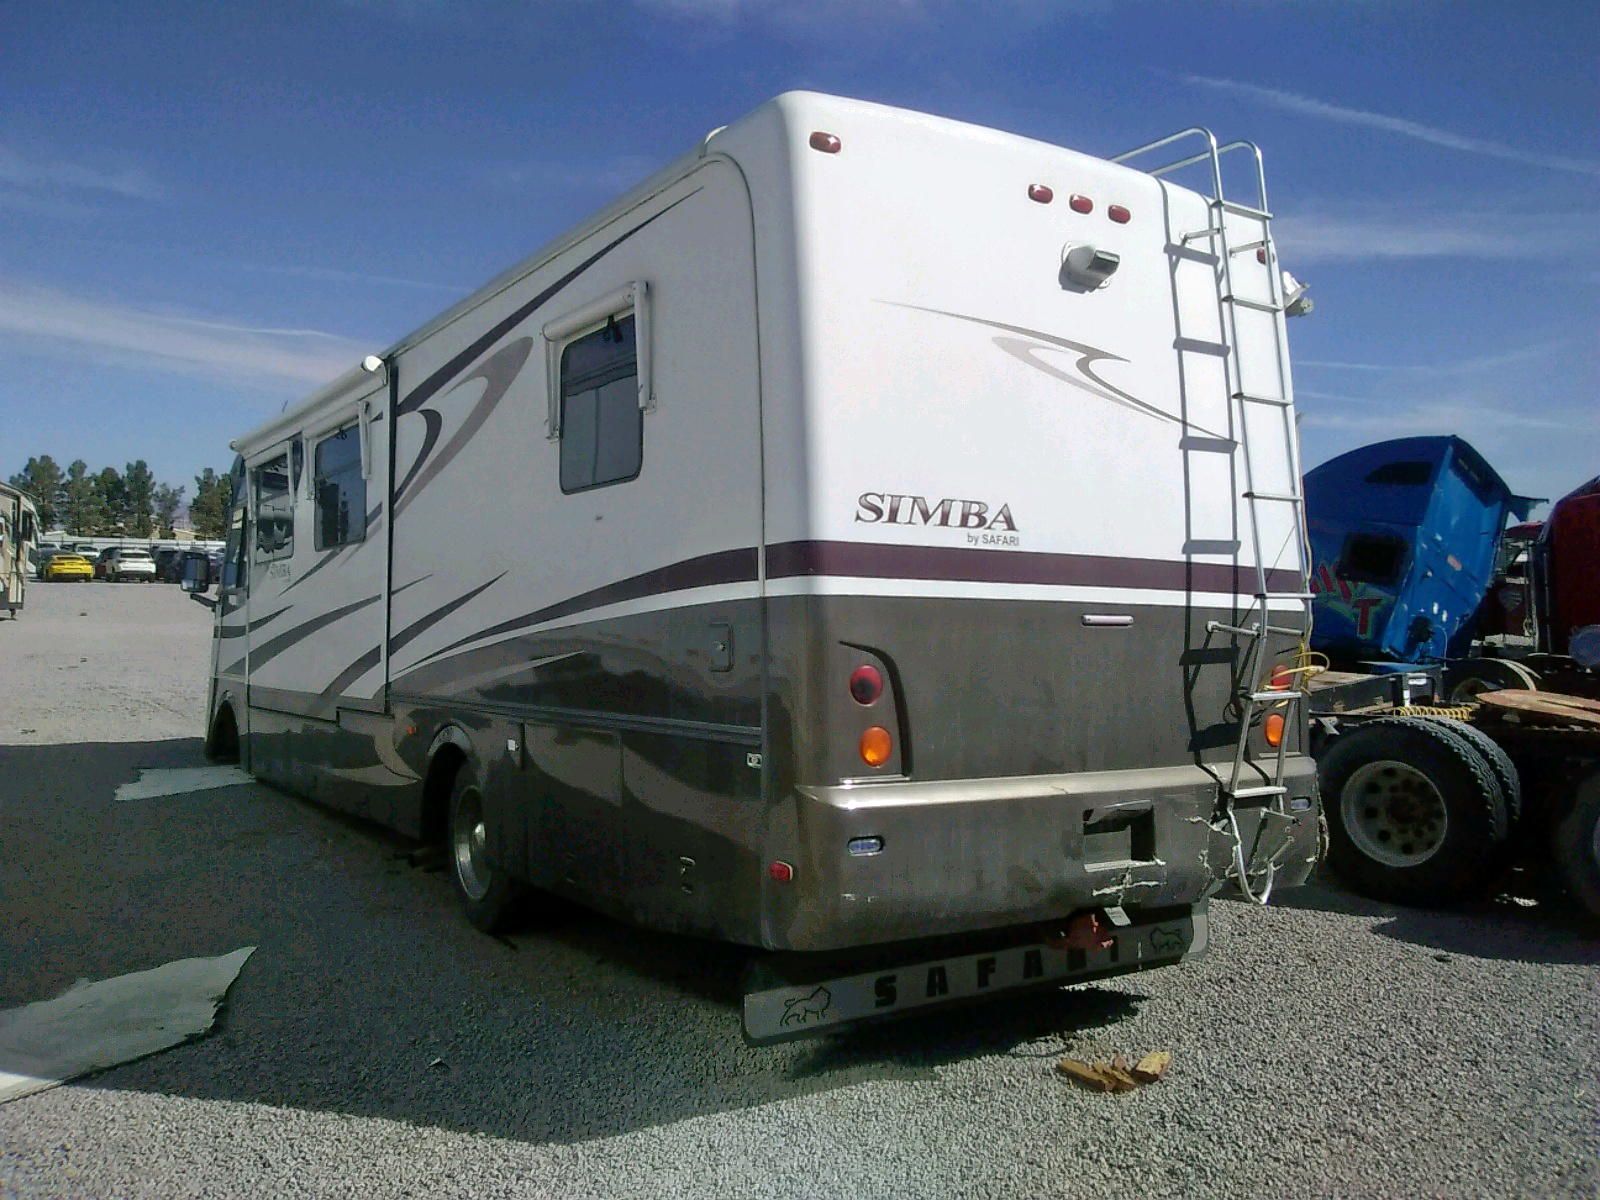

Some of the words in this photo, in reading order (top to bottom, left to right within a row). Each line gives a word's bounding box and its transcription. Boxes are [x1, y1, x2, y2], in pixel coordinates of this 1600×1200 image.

[855, 492, 1019, 532] SIMBA
[967, 532, 980, 546] by
[982, 533, 1020, 547] SAFARI
